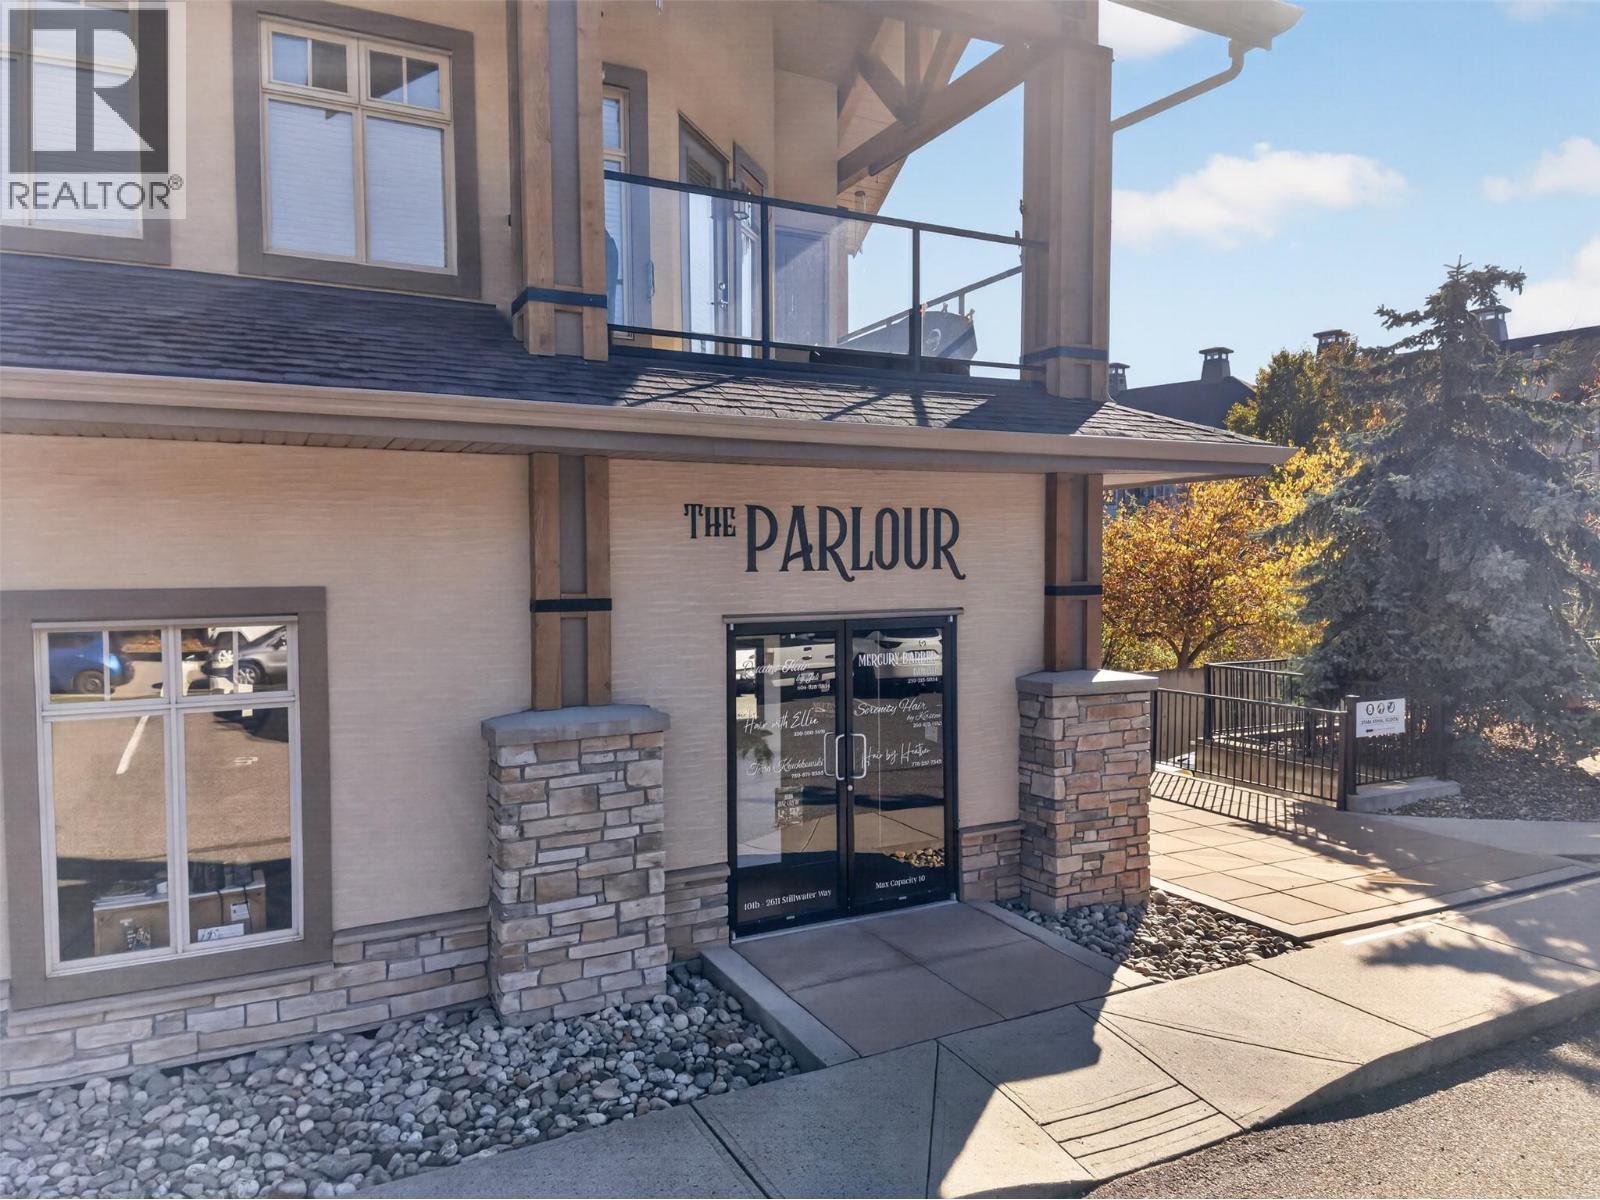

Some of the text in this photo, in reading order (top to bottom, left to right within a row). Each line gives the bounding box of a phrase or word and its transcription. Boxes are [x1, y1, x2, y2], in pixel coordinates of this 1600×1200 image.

[684, 504, 966, 582] THE PARLOUR
[858, 652, 900, 668] MERCURY
[854, 698, 926, 716] Serenity Hair
[790, 707, 820, 729] Ellie
[886, 749, 897, 765] by
[875, 881, 890, 889] Max
[890, 876, 918, 887] Capacity
[781, 892, 817, 904] Stillwater
[818, 889, 832, 897] Way
